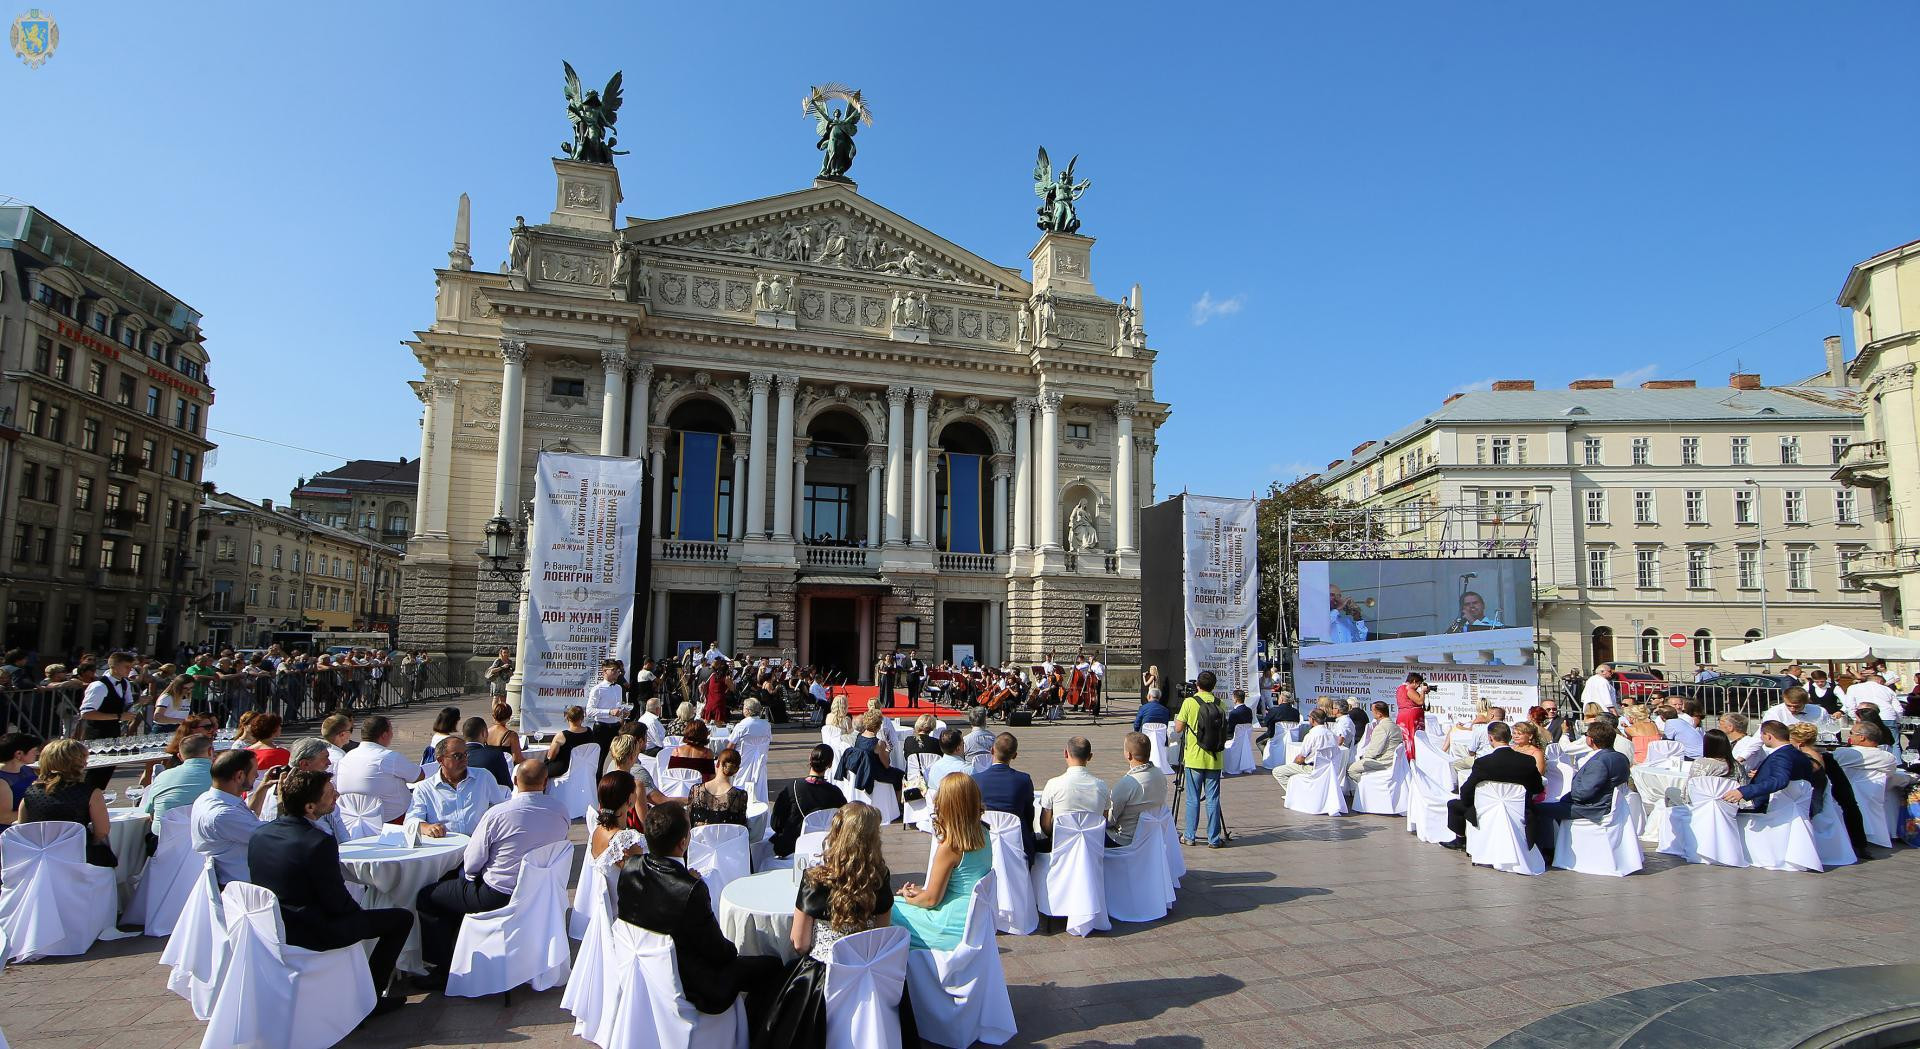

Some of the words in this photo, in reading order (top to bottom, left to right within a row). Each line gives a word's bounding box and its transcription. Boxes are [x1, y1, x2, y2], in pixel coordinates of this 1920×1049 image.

[578, 478, 589, 512] ГОФМАНА
[607, 489, 626, 498] ЖУАН
[577, 513, 586, 536] КАЗКИ
[596, 497, 606, 544] ПУЛЬЧИНЕЛЛА
[605, 498, 618, 550] СВЯЩЕННА
[586, 529, 596, 556] МИКИТА
[1234, 534, 1243, 578] СВЯЩЕННА
[552, 562, 578, 572] Вагнер
[603, 552, 615, 584] ВЕСНА
[543, 571, 593, 583] ЛОЕНГРІН
[1234, 580, 1242, 605] ВЕСНА
[1194, 594, 1227, 605] ЛОЕНГРІН
[541, 611, 566, 624] ДОН
[569, 612, 602, 625] ЖУАН
[609, 608, 619, 648] ПАПОРОТЬ
[1194, 628, 1211, 639] ДОН
[1213, 628, 1235, 640] ЖУАН
[569, 634, 607, 643] ЛОЕНГРІН
[1240, 624, 1248, 658] ПАПОРОТЬ
[541, 651, 563, 660] КОЛИ
[565, 652, 588, 661] ЦВІТЕ
[546, 661, 587, 670] ПАПОРОТЬ
[1430, 672, 1468, 682] МИКИТА
[538, 687, 554, 697] ЛИС
[555, 688, 585, 698] МИКИТА
[1314, 685, 1371, 695] ПУЛЬЧИНЕЛЛА
